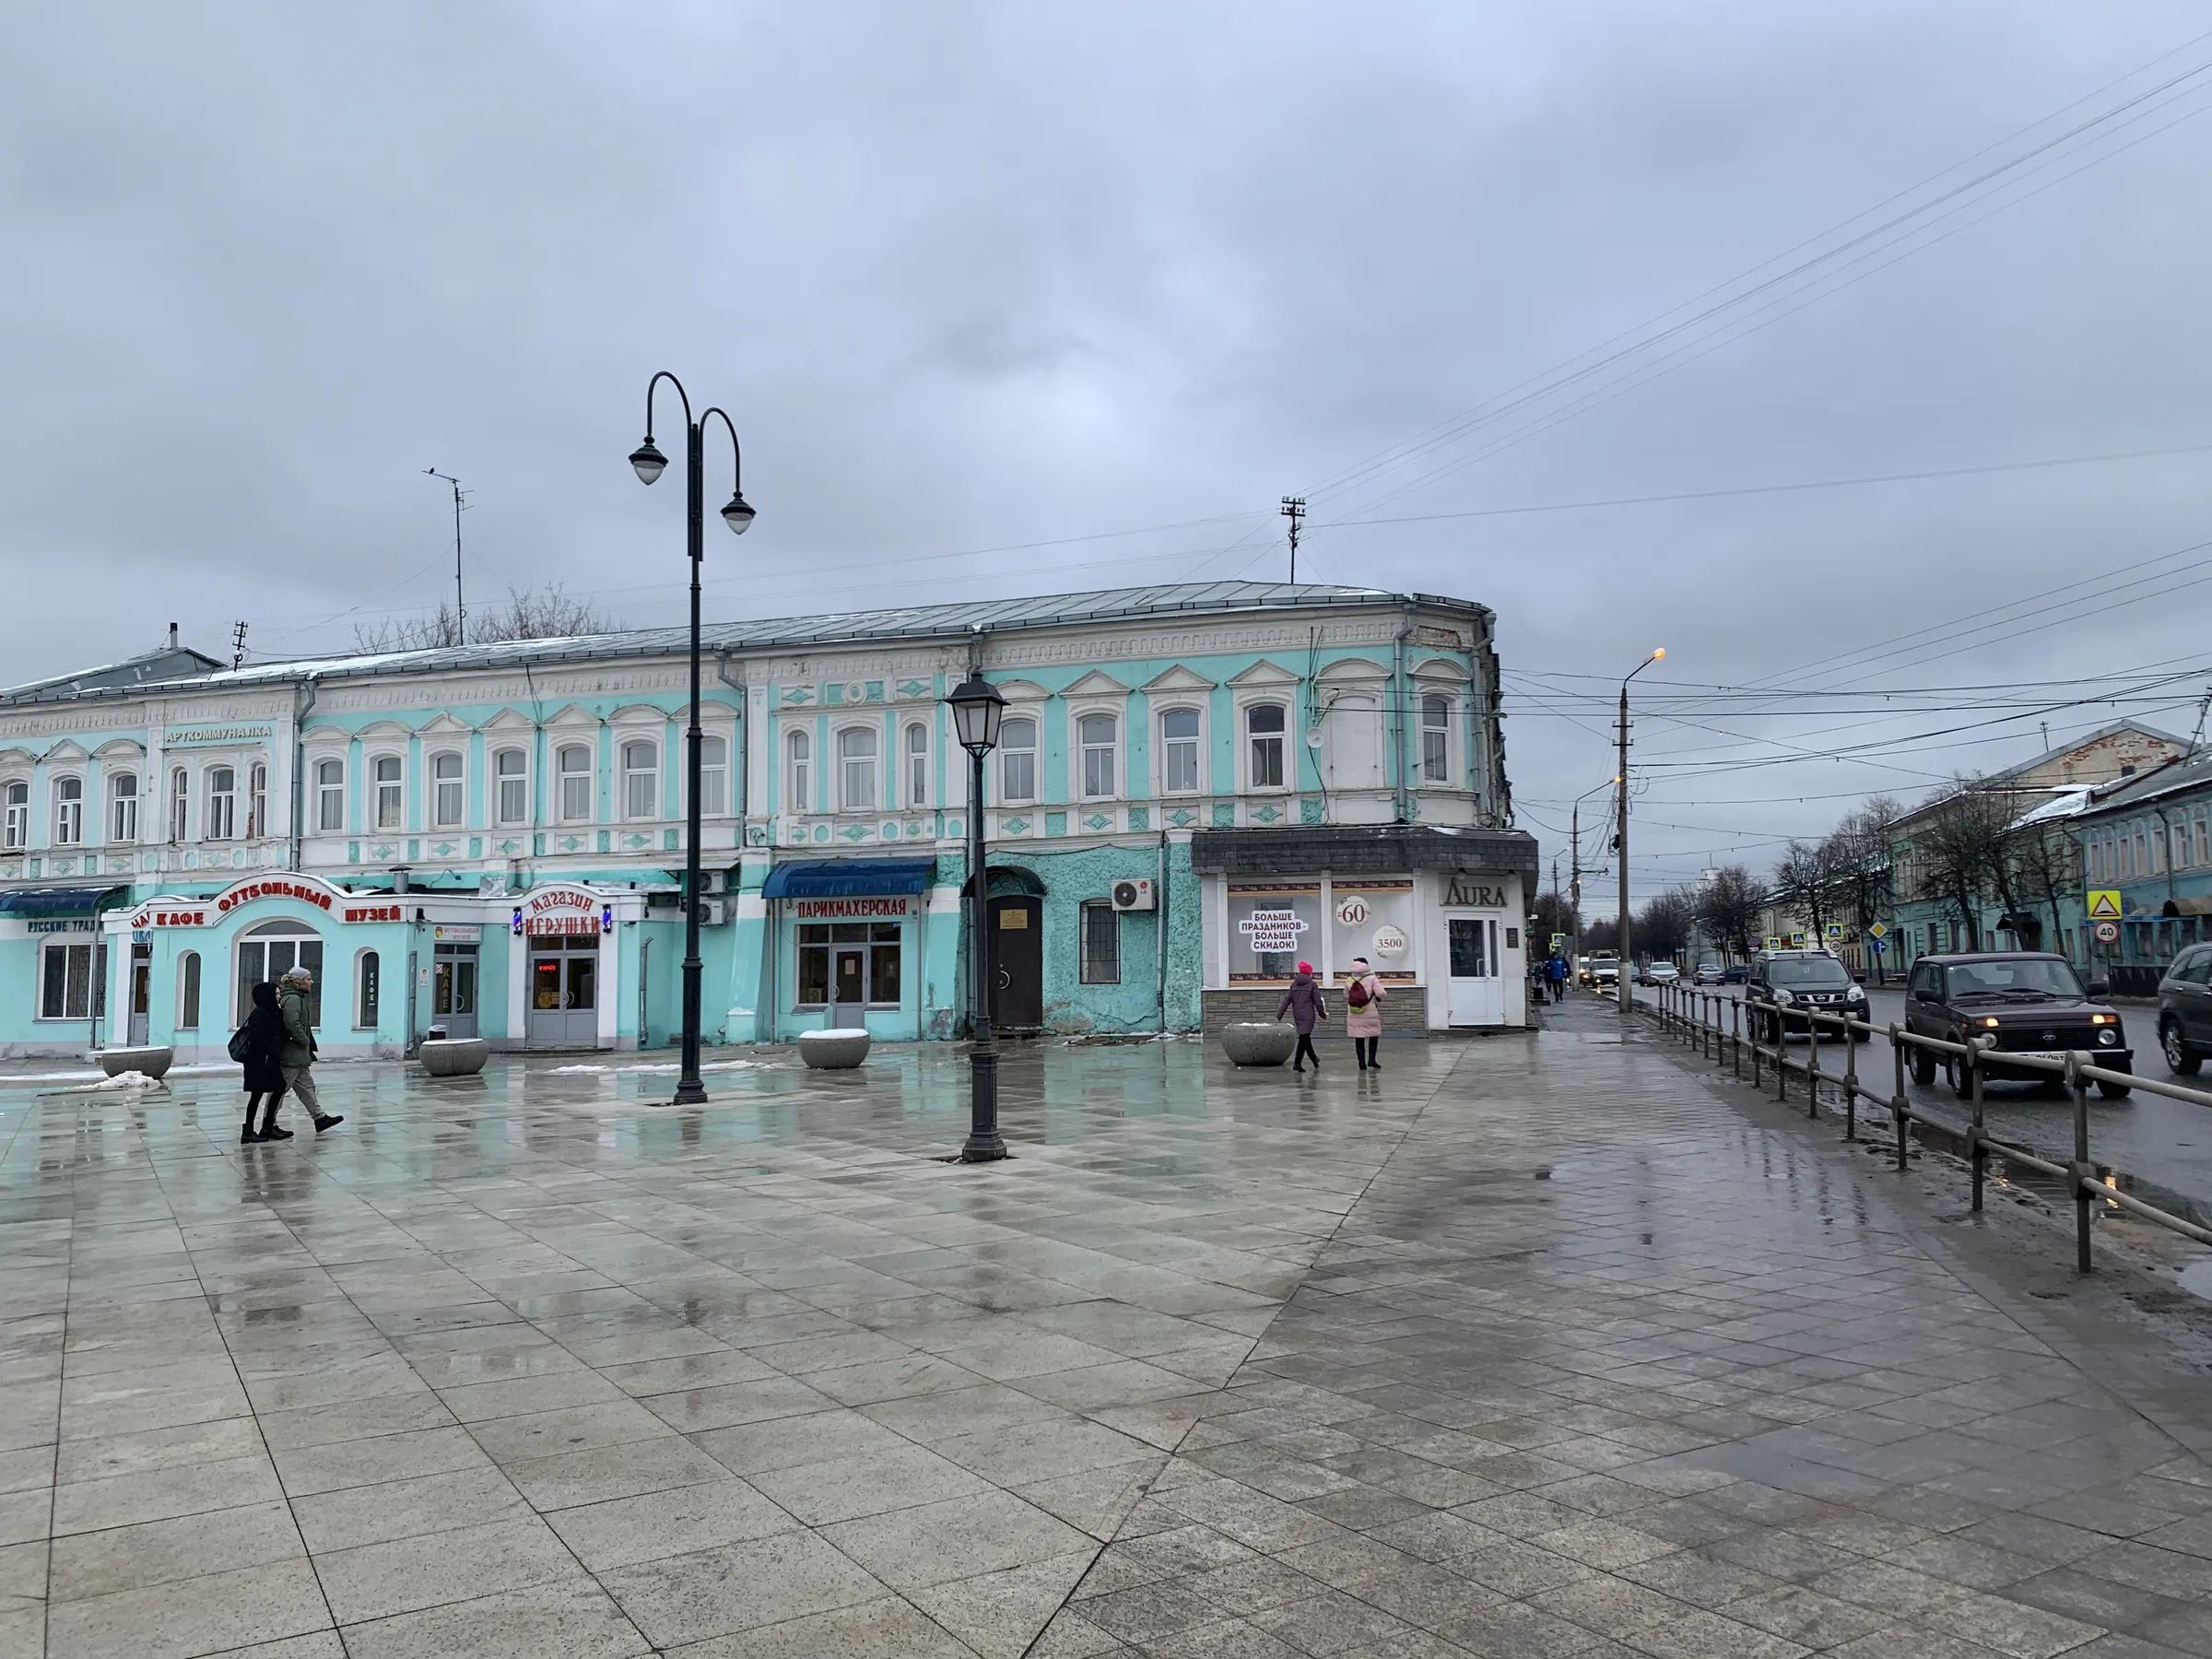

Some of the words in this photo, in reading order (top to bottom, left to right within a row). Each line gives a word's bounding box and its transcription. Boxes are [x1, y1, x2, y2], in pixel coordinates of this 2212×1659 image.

[167, 726, 273, 743] АРТКОММУНАЛКА
[218, 882, 333, 911] ФУТБОЛЬНЫЙ
[1444, 877, 1508, 905] AURA
[345, 905, 401, 922] МУЗЕЙ
[798, 899, 906, 918] ПАРИКМАХЕРСКАЯ
[157, 912, 205, 925] КАФЕ
[1254, 912, 1292, 922] БОЛЬШЕ
[28, 922, 67, 933] РУССКИЕ
[525, 916, 600, 936] ИГРУШКИ
[1241, 923, 1301, 931] ПРАЗДНИКОВ
[2100, 927, 2113, 936] 40
[1255, 932, 1293, 940] БОЛЬШЕ
[1253, 941, 1295, 949] СКИДОК!
[1377, 938, 1403, 948] 3500
